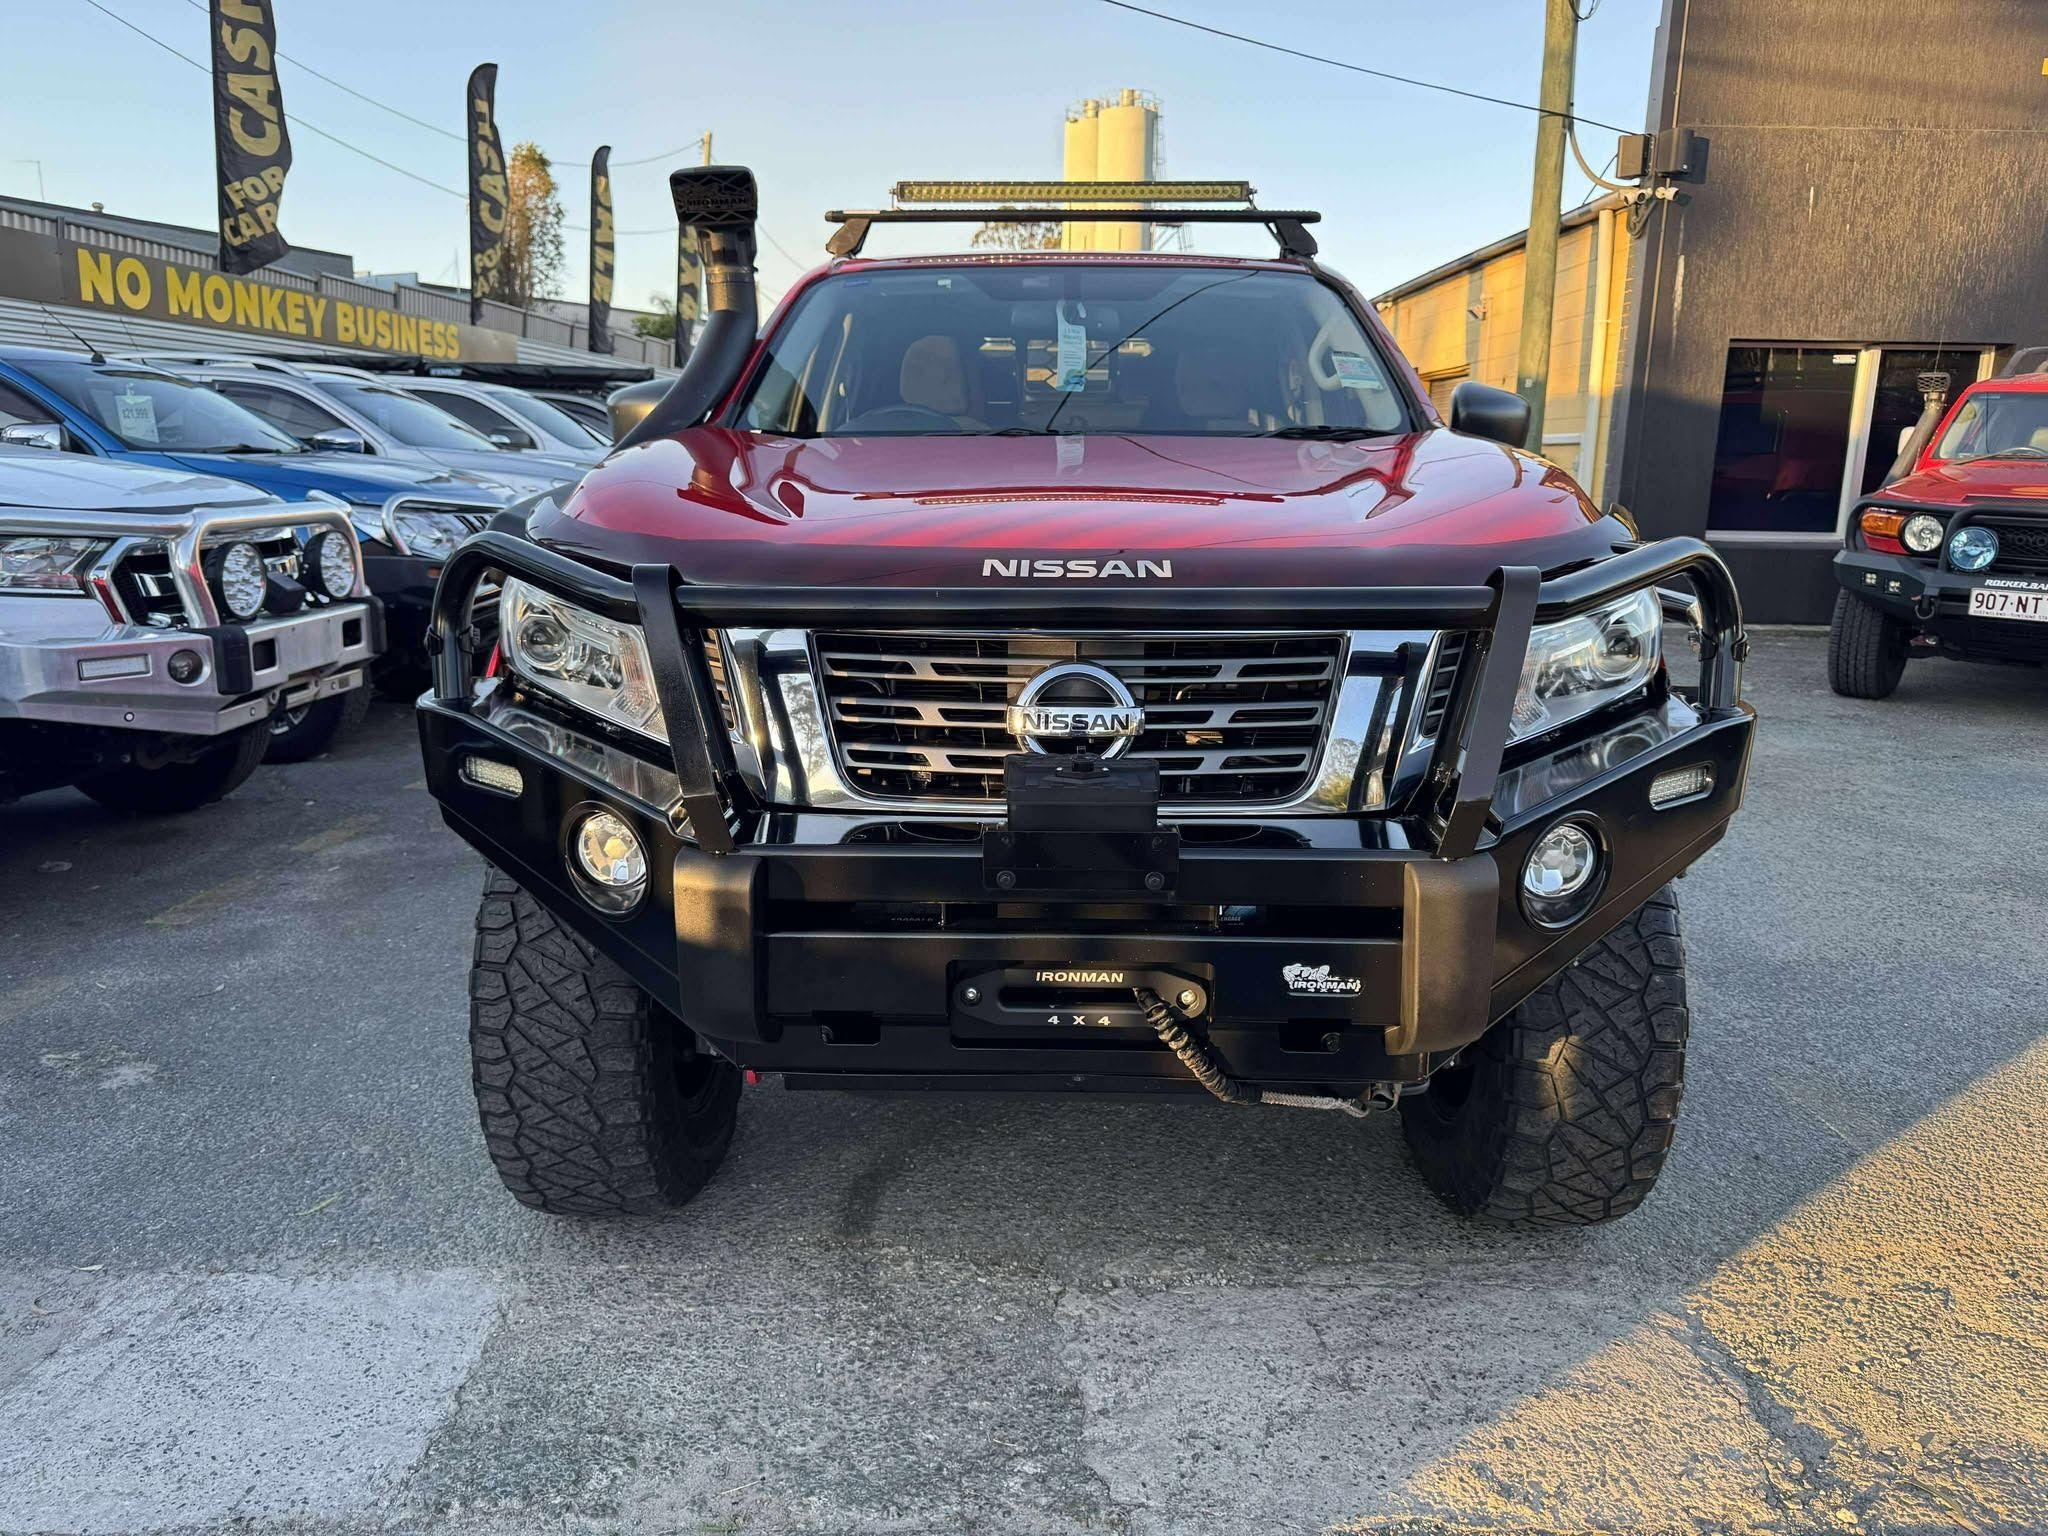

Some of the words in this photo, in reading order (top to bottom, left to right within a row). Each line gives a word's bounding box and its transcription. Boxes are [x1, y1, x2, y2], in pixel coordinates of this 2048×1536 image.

[224, 165, 285, 210] FOR
[76, 247, 152, 311] NO
[165, 265, 328, 338] MONKEY
[335, 301, 461, 360] BUSINESS
[981, 558, 1173, 579] NISSAN
[1984, 579, 2028, 589] ROCKER
[1020, 713, 1131, 732] NISSAN
[1035, 971, 1124, 983] IRONMAN
[1293, 980, 1358, 990] IRONMAN
[1047, 1015, 1060, 1025] 4
[1072, 1015, 1086, 1025] X
[1097, 1015, 1111, 1026] 4
